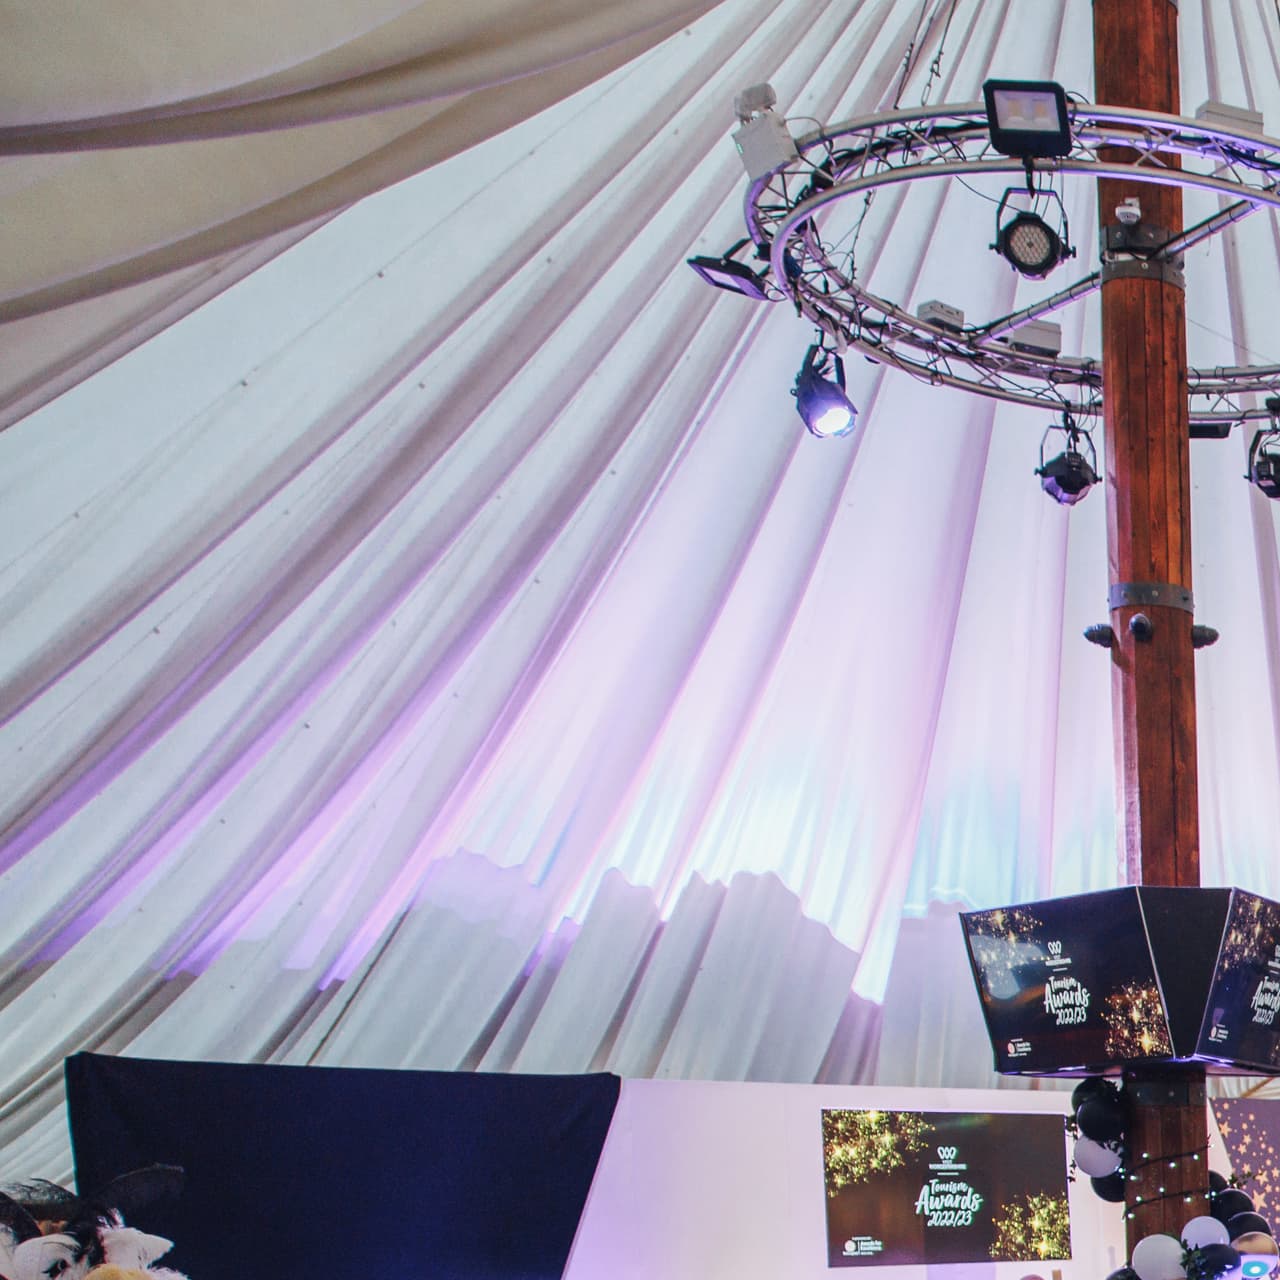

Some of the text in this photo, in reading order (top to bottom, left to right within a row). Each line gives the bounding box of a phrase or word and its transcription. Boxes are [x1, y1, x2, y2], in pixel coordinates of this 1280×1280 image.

[1043, 982, 1091, 1014] Awards
[1055, 1006, 1087, 1026] 2022/23
[928, 1178, 969, 1195] Tourism
[914, 1184, 984, 1216] Awards
[927, 1209, 973, 1227] 2022/23
